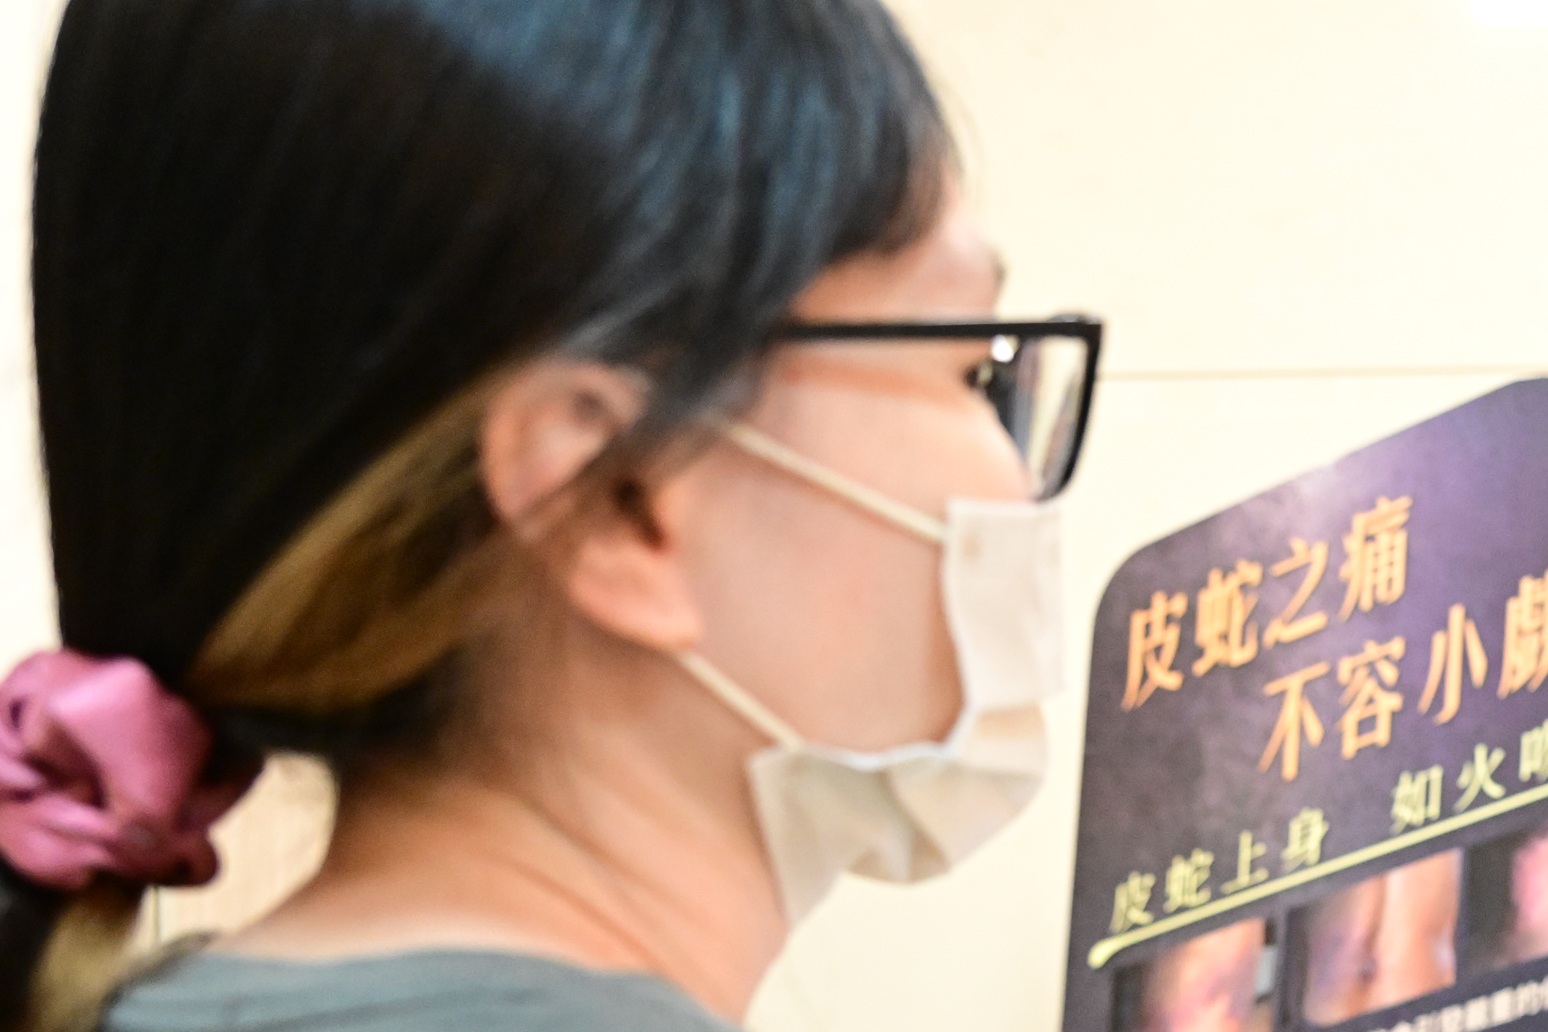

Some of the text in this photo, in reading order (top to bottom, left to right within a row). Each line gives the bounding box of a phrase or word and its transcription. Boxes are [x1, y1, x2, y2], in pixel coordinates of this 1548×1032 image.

[1121, 495, 1413, 713] 皮蛇之痛
[1109, 807, 1330, 934] 皮蛇上身
